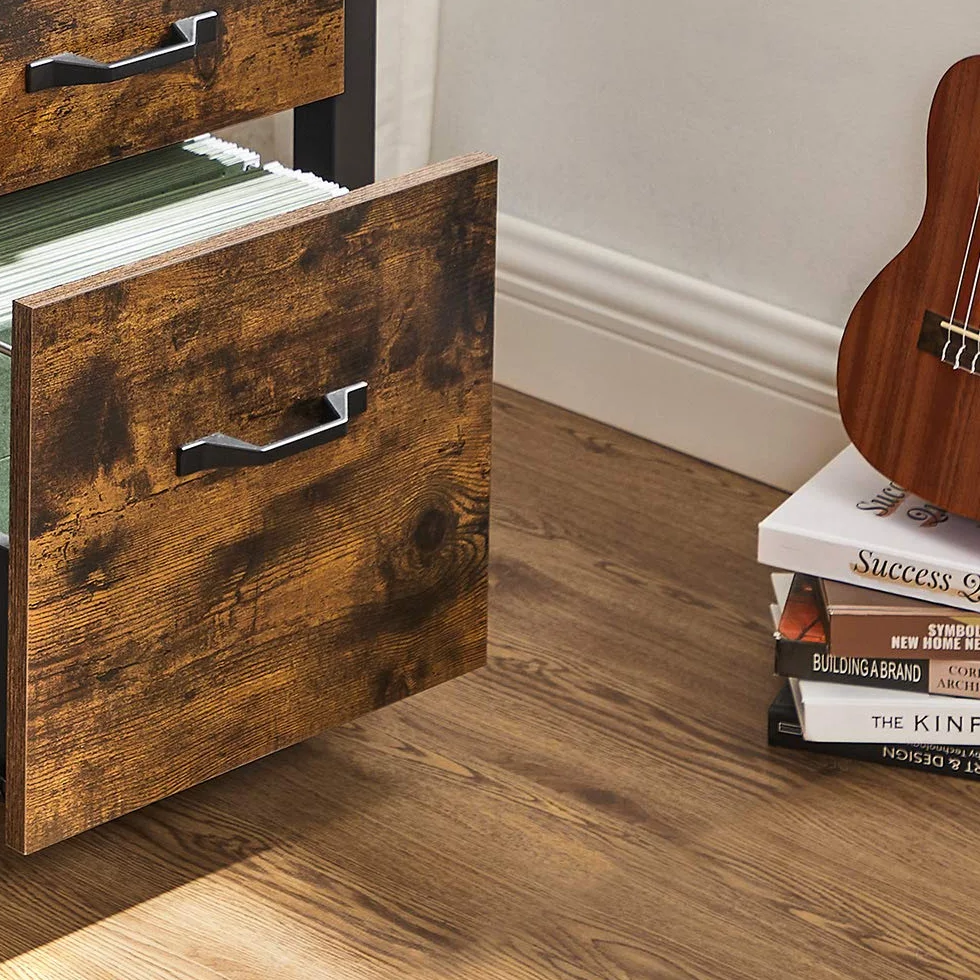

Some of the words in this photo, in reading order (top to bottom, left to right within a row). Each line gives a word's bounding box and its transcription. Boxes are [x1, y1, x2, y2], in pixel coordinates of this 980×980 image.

[853, 549, 952, 591] Success
[891, 636, 919, 649] NEW
[923, 636, 961, 650] HOME
[813, 653, 869, 677] BUILDING
[870, 660, 879, 678] A
[880, 661, 922, 683] BRAND
[871, 716, 904, 729] THE
[883, 746, 944, 768] DESIGN
[949, 757, 961, 771] &
